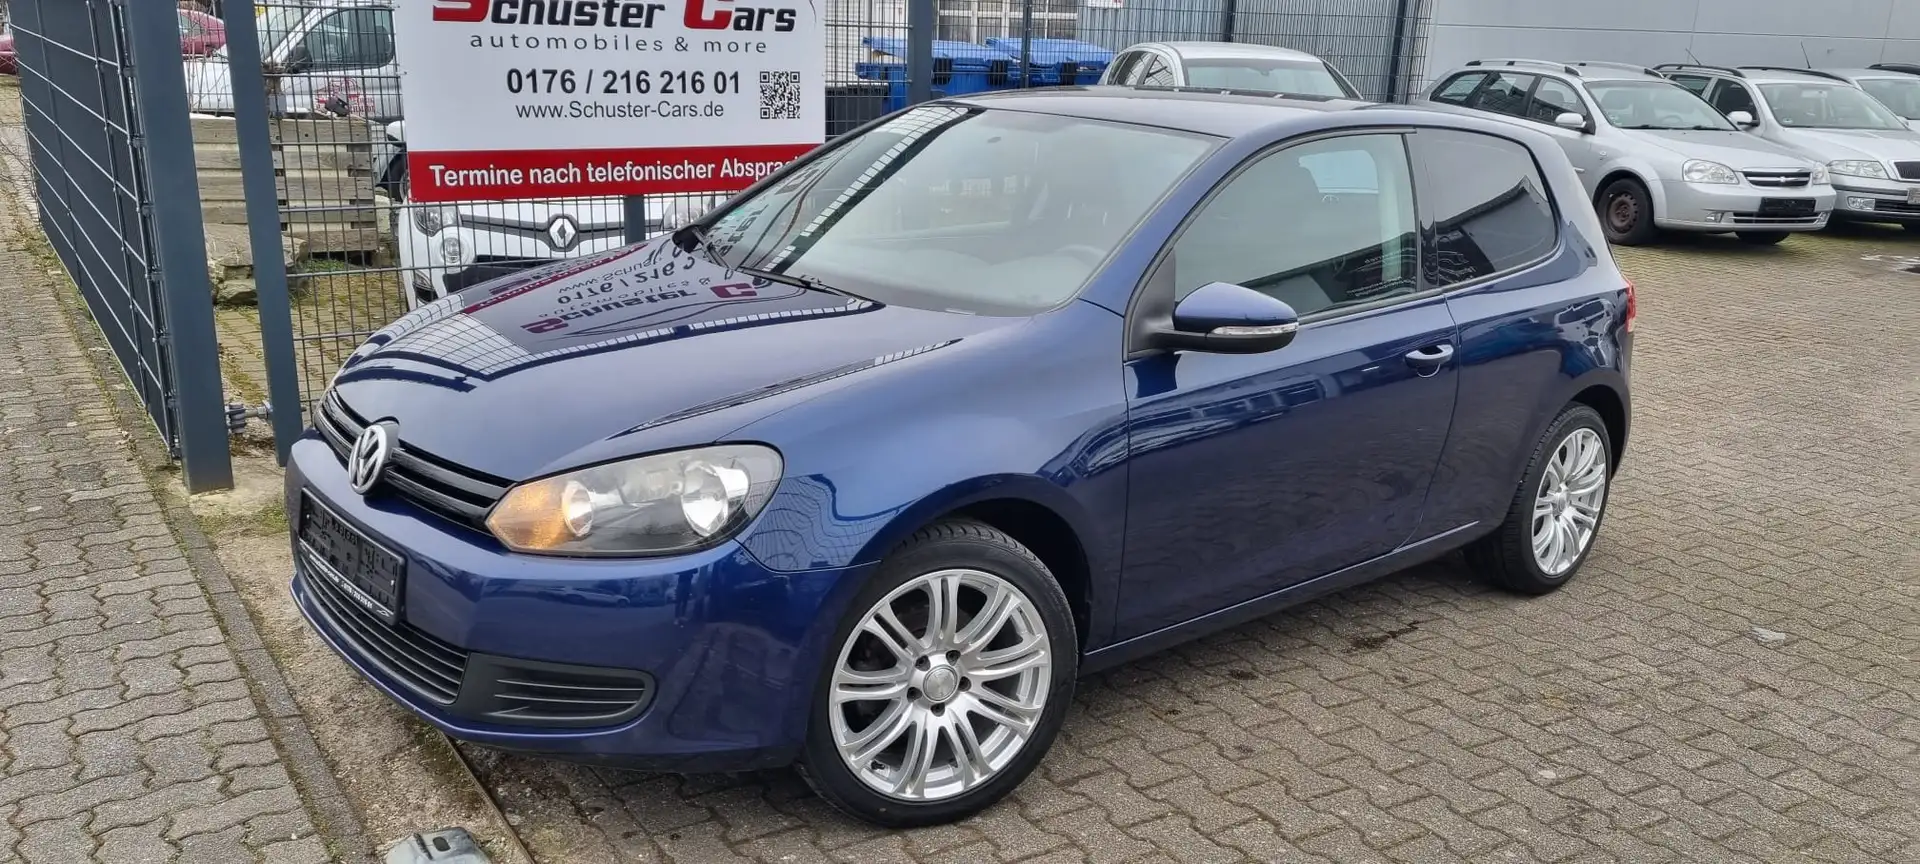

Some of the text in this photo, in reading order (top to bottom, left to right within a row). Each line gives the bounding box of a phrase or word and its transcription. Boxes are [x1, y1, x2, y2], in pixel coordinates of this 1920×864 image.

[433, 0, 797, 32] Schuster Cars
[470, 33, 767, 53] automobiles & more
[507, 68, 739, 94] 0176 / 216 216 01
[515, 100, 724, 118] www.Schuster-Cars.de
[429, 164, 523, 187] Termine
[529, 163, 581, 184] nach
[586, 160, 715, 183] telefonischer
